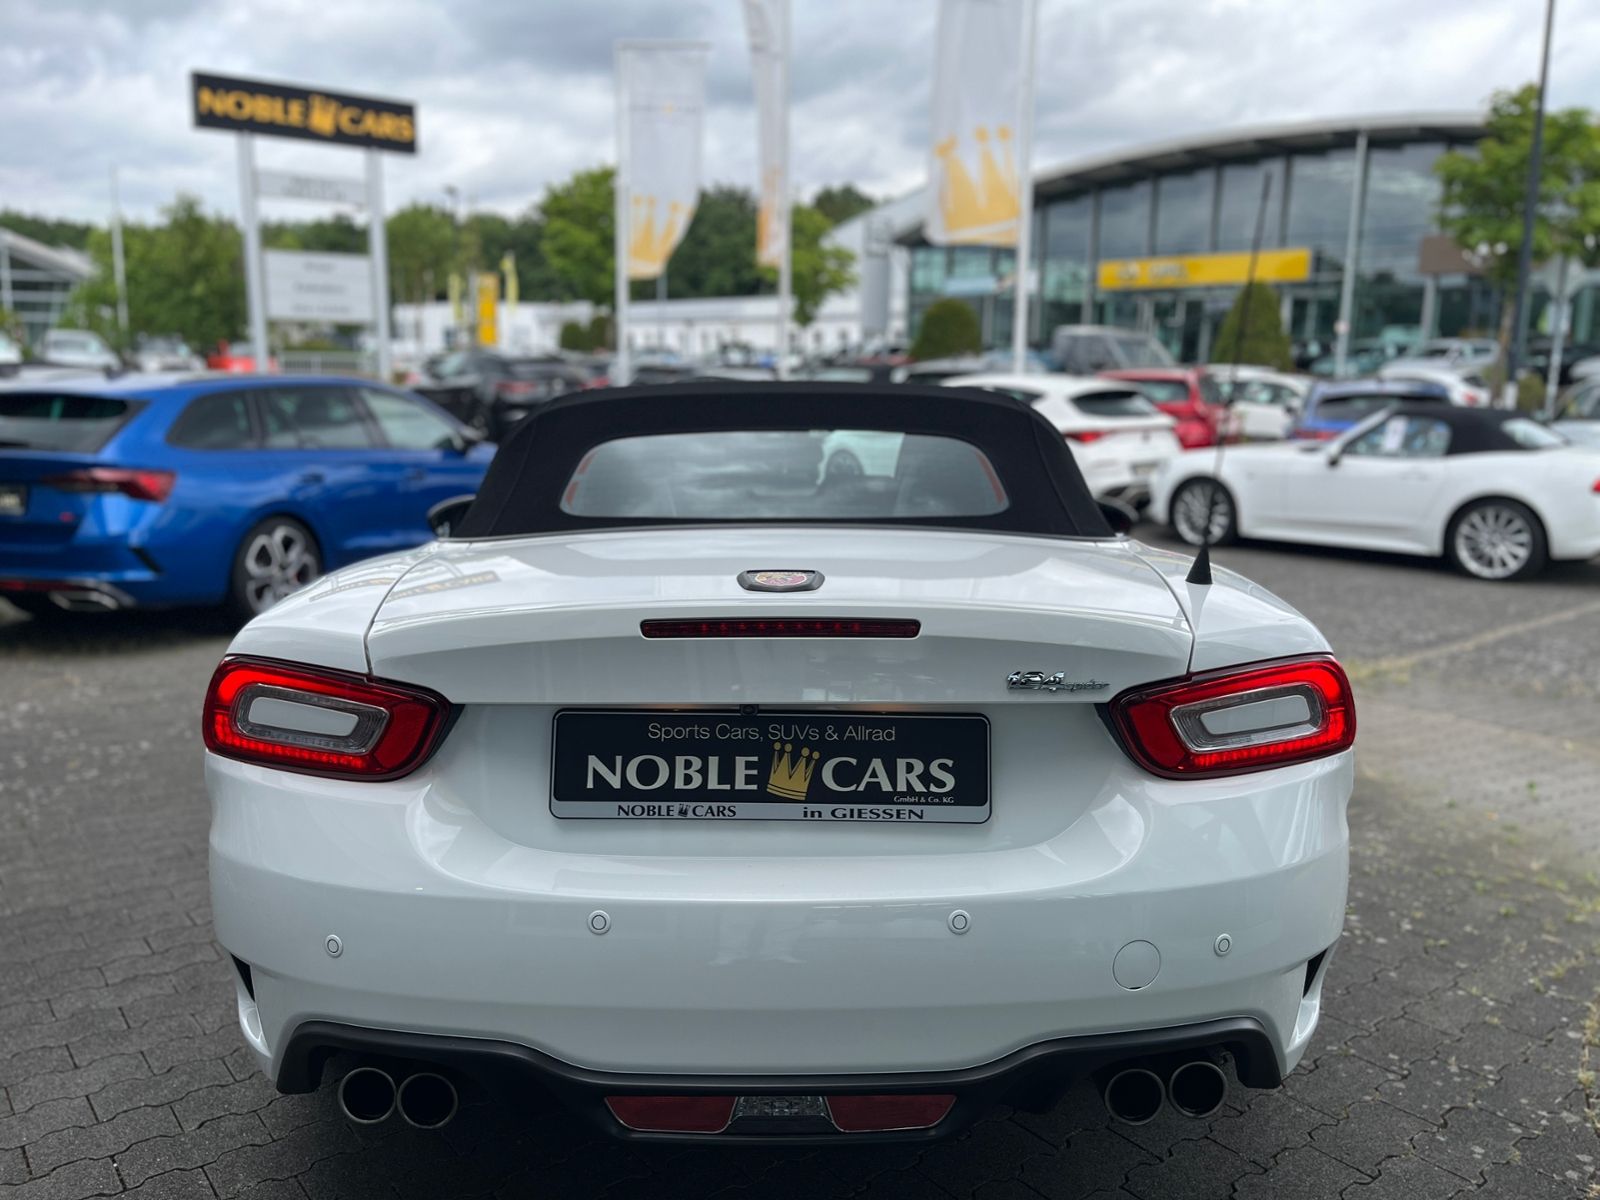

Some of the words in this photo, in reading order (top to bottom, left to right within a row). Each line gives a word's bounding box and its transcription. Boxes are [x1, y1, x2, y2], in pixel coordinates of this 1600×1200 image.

[198, 86, 306, 128] NOBLE
[339, 107, 414, 143] CARS
[1007, 671, 1065, 693] 124
[647, 722, 711, 742] Sports
[715, 723, 764, 742] Cars,
[767, 723, 820, 740] SUVs
[824, 725, 840, 741] &
[843, 726, 896, 741] Allrad
[586, 754, 759, 791] NOBLE
[821, 757, 956, 793] CARS
[617, 804, 675, 817] NOBLE
[692, 804, 737, 817] CARS
[803, 806, 823, 818] in
[830, 807, 924, 819] GIESSEN
